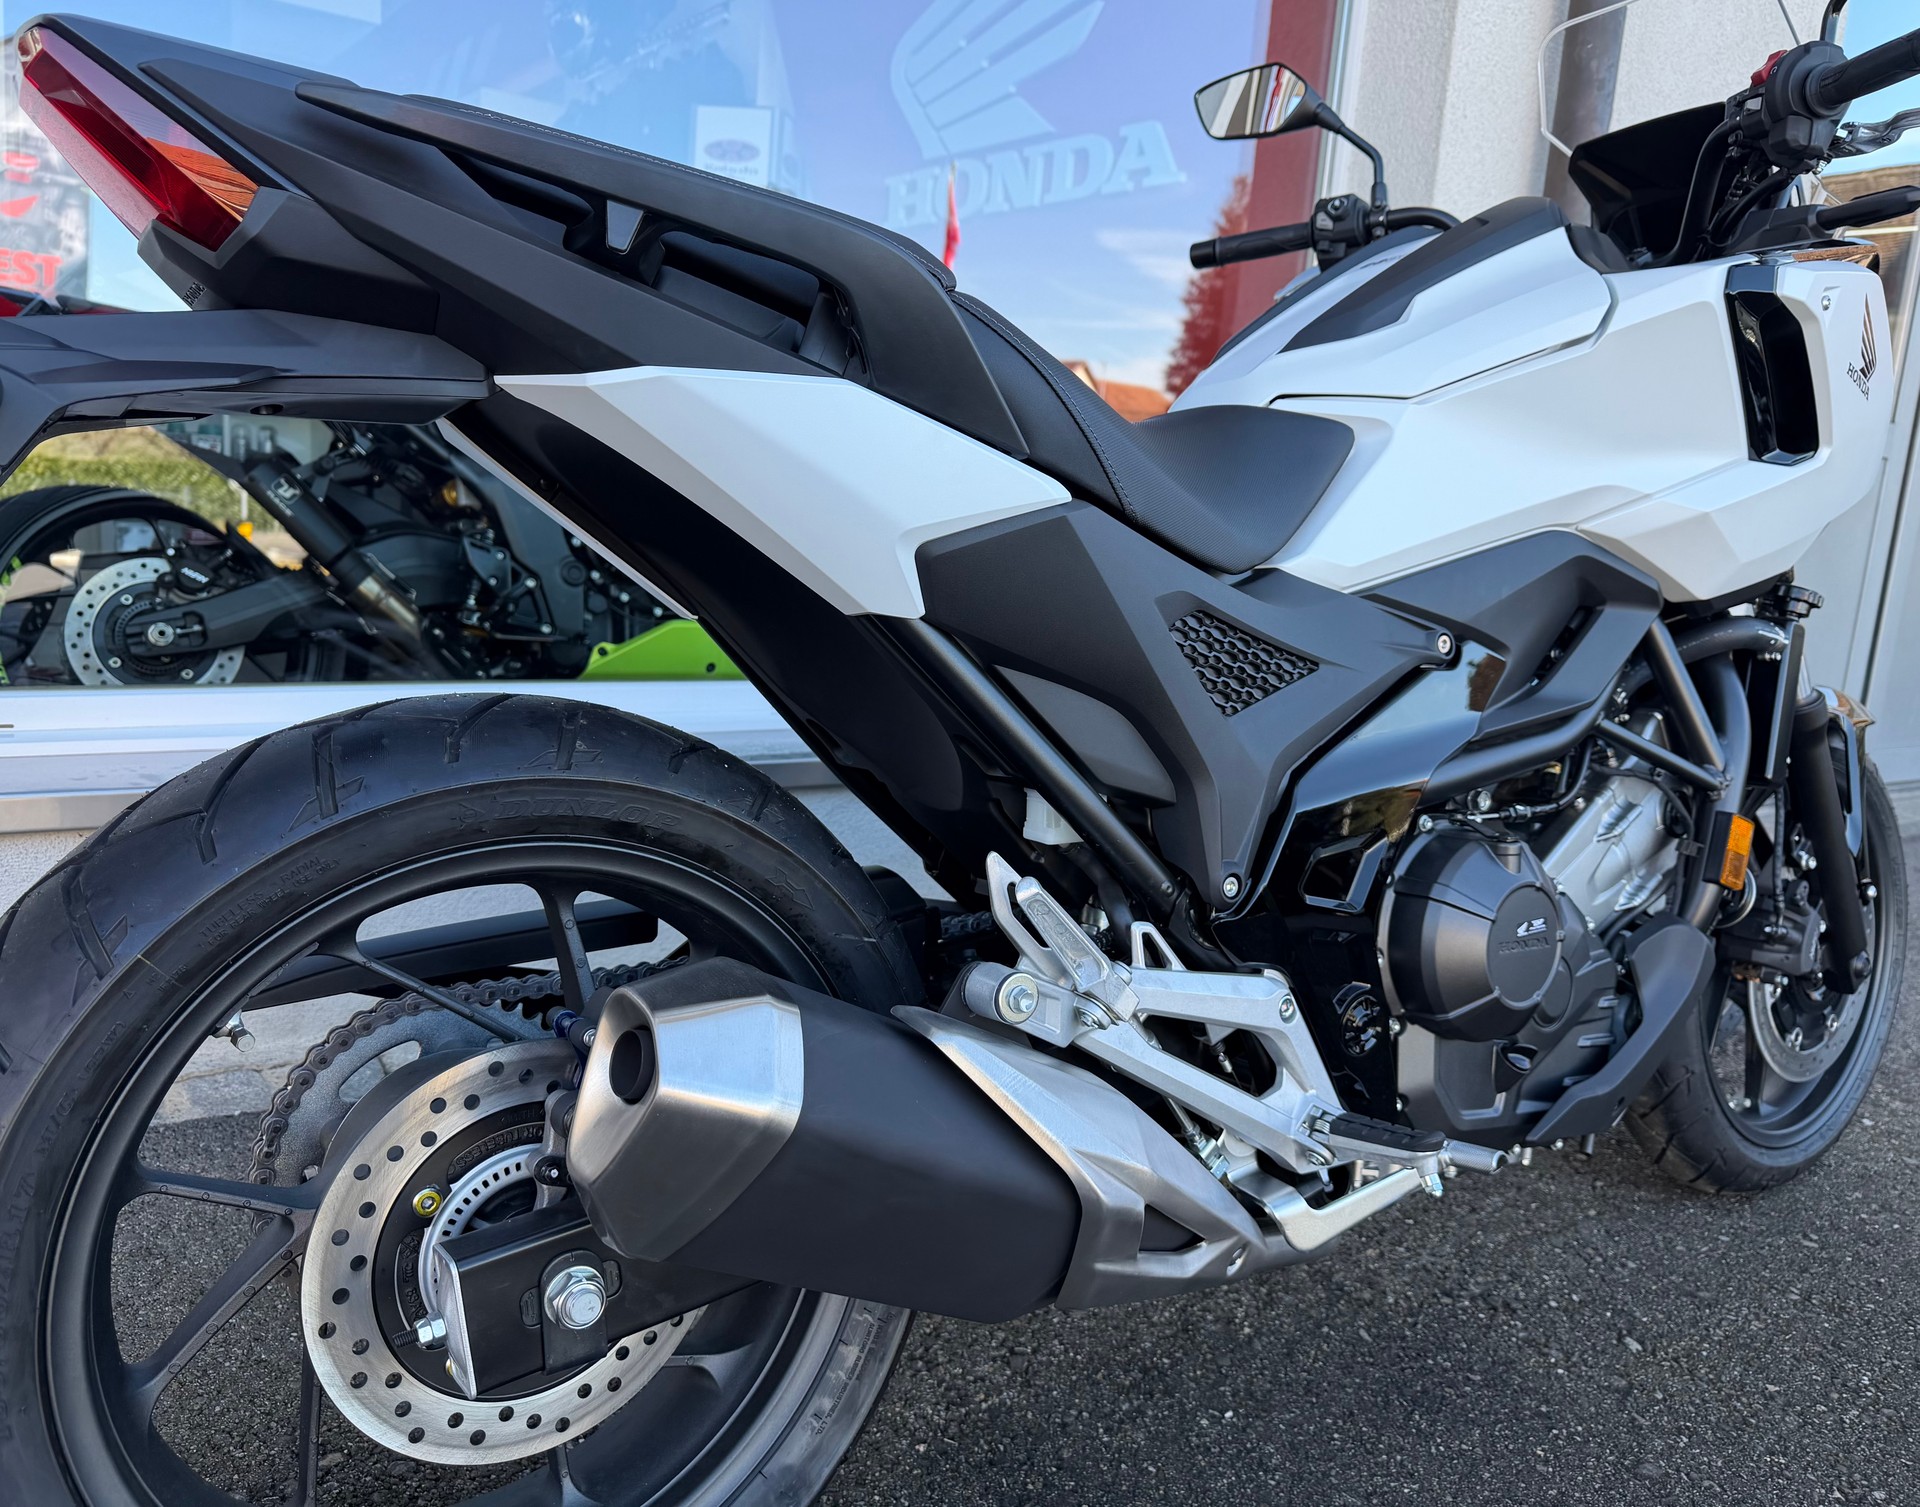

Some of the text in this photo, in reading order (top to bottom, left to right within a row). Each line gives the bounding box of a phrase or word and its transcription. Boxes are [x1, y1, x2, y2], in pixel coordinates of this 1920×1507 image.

[885, 119, 1187, 229] HONDA
[1846, 361, 1870, 401] HONDA
[495, 797, 683, 830] DUNLOP
[200, 855, 325, 940] TUBELESS RADIAL
[1497, 936, 1552, 954] HONDA
